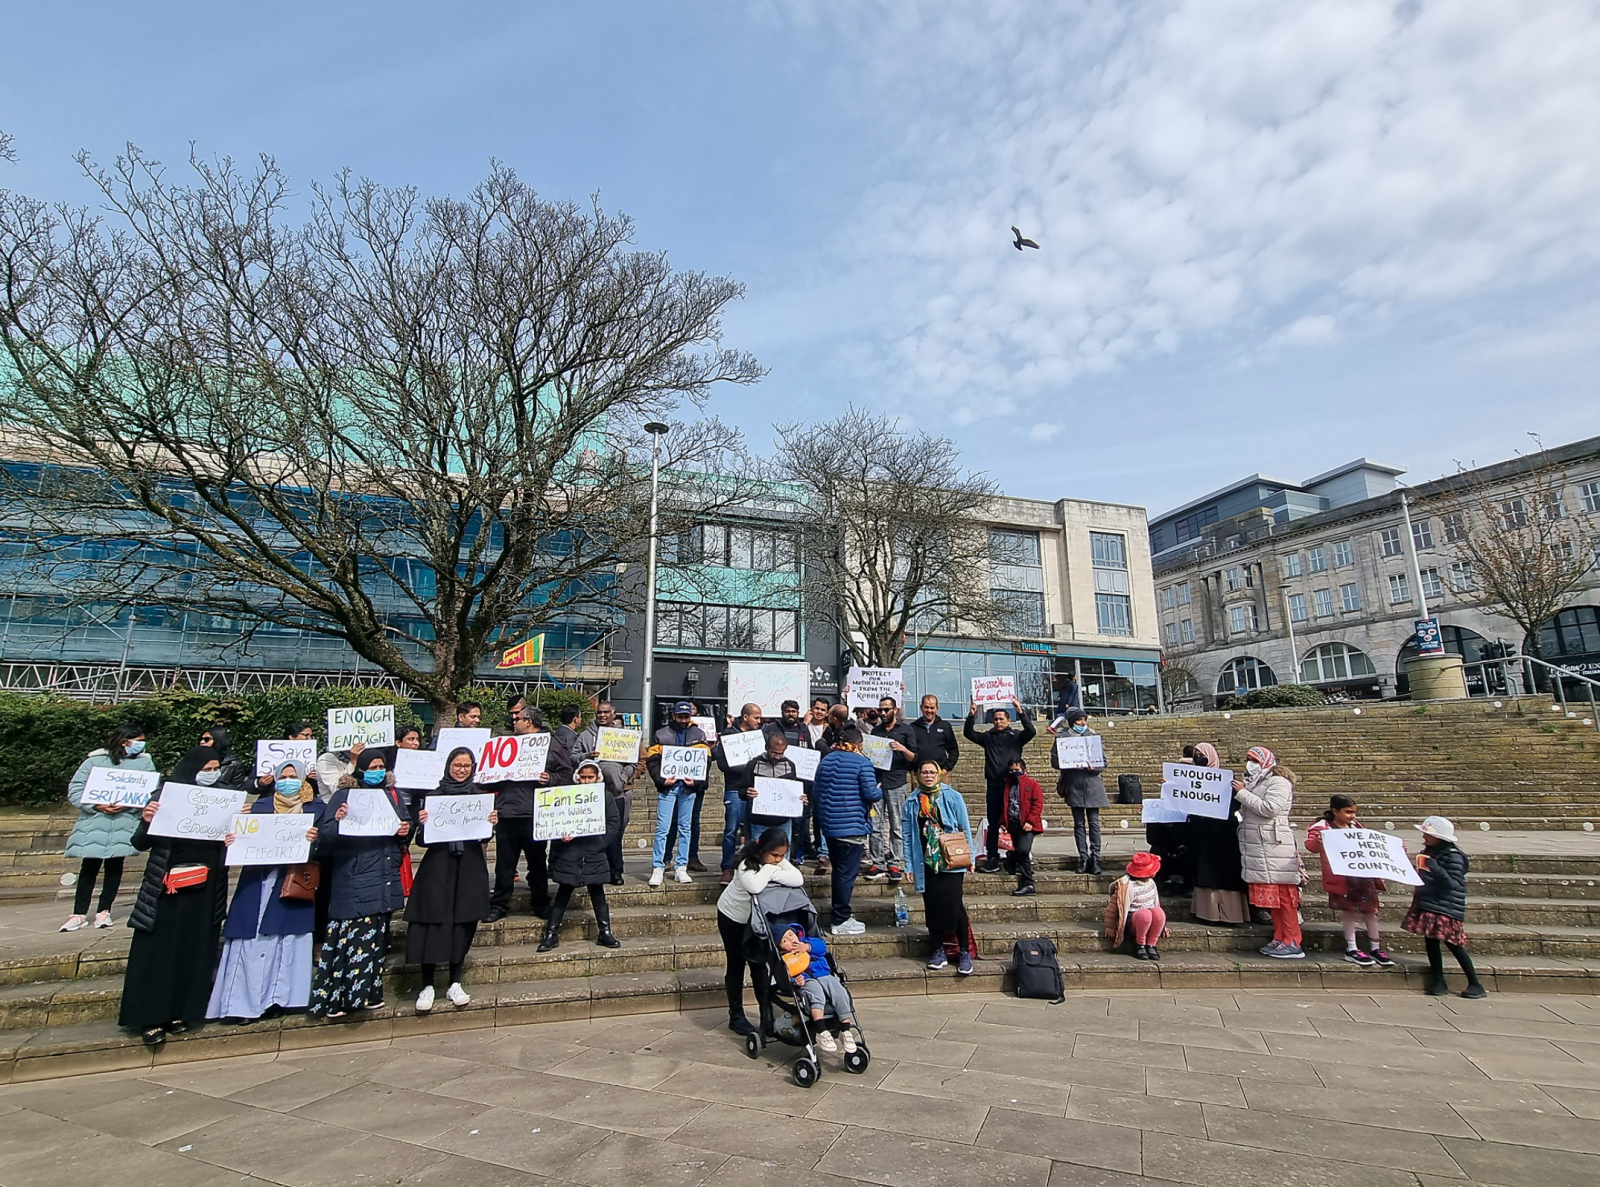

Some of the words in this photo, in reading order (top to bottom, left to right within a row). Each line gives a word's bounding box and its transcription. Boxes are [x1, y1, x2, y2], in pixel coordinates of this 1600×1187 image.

[1021, 642, 1039, 650] Turtle
[1040, 643, 1052, 652] Bay
[974, 690, 985, 701] for
[334, 708, 391, 724] ENOUGH
[521, 736, 549, 749] FOOD
[264, 742, 312, 759] Save
[478, 736, 518, 772] NO
[664, 750, 706, 763] #GOTA
[518, 754, 539, 762] GAS
[662, 764, 677, 775] GO
[1173, 769, 1222, 782] ENOUGH
[479, 771, 501, 783] People
[504, 771, 515, 779] are
[1190, 781, 1202, 789] IS
[88, 789, 113, 802] SRI
[115, 791, 149, 805] LANKA
[186, 788, 238, 809] Enough
[538, 790, 551, 808] I
[554, 797, 571, 808] am
[772, 792, 783, 801] IS
[1172, 789, 1220, 803] ENOUGH
[568, 808, 592, 816] Wales
[233, 816, 259, 835] NO
[274, 816, 307, 827] FOOD
[433, 815, 456, 827] Go
[176, 817, 230, 839] Enough
[274, 829, 301, 842] GAS
[1344, 832, 1364, 840] WE
[1368, 833, 1388, 844] ARE
[1358, 841, 1388, 852] HERE
[1340, 851, 1366, 859] FOR
[1369, 850, 1394, 863] OUR
[1348, 862, 1407, 877] COUNTRY
